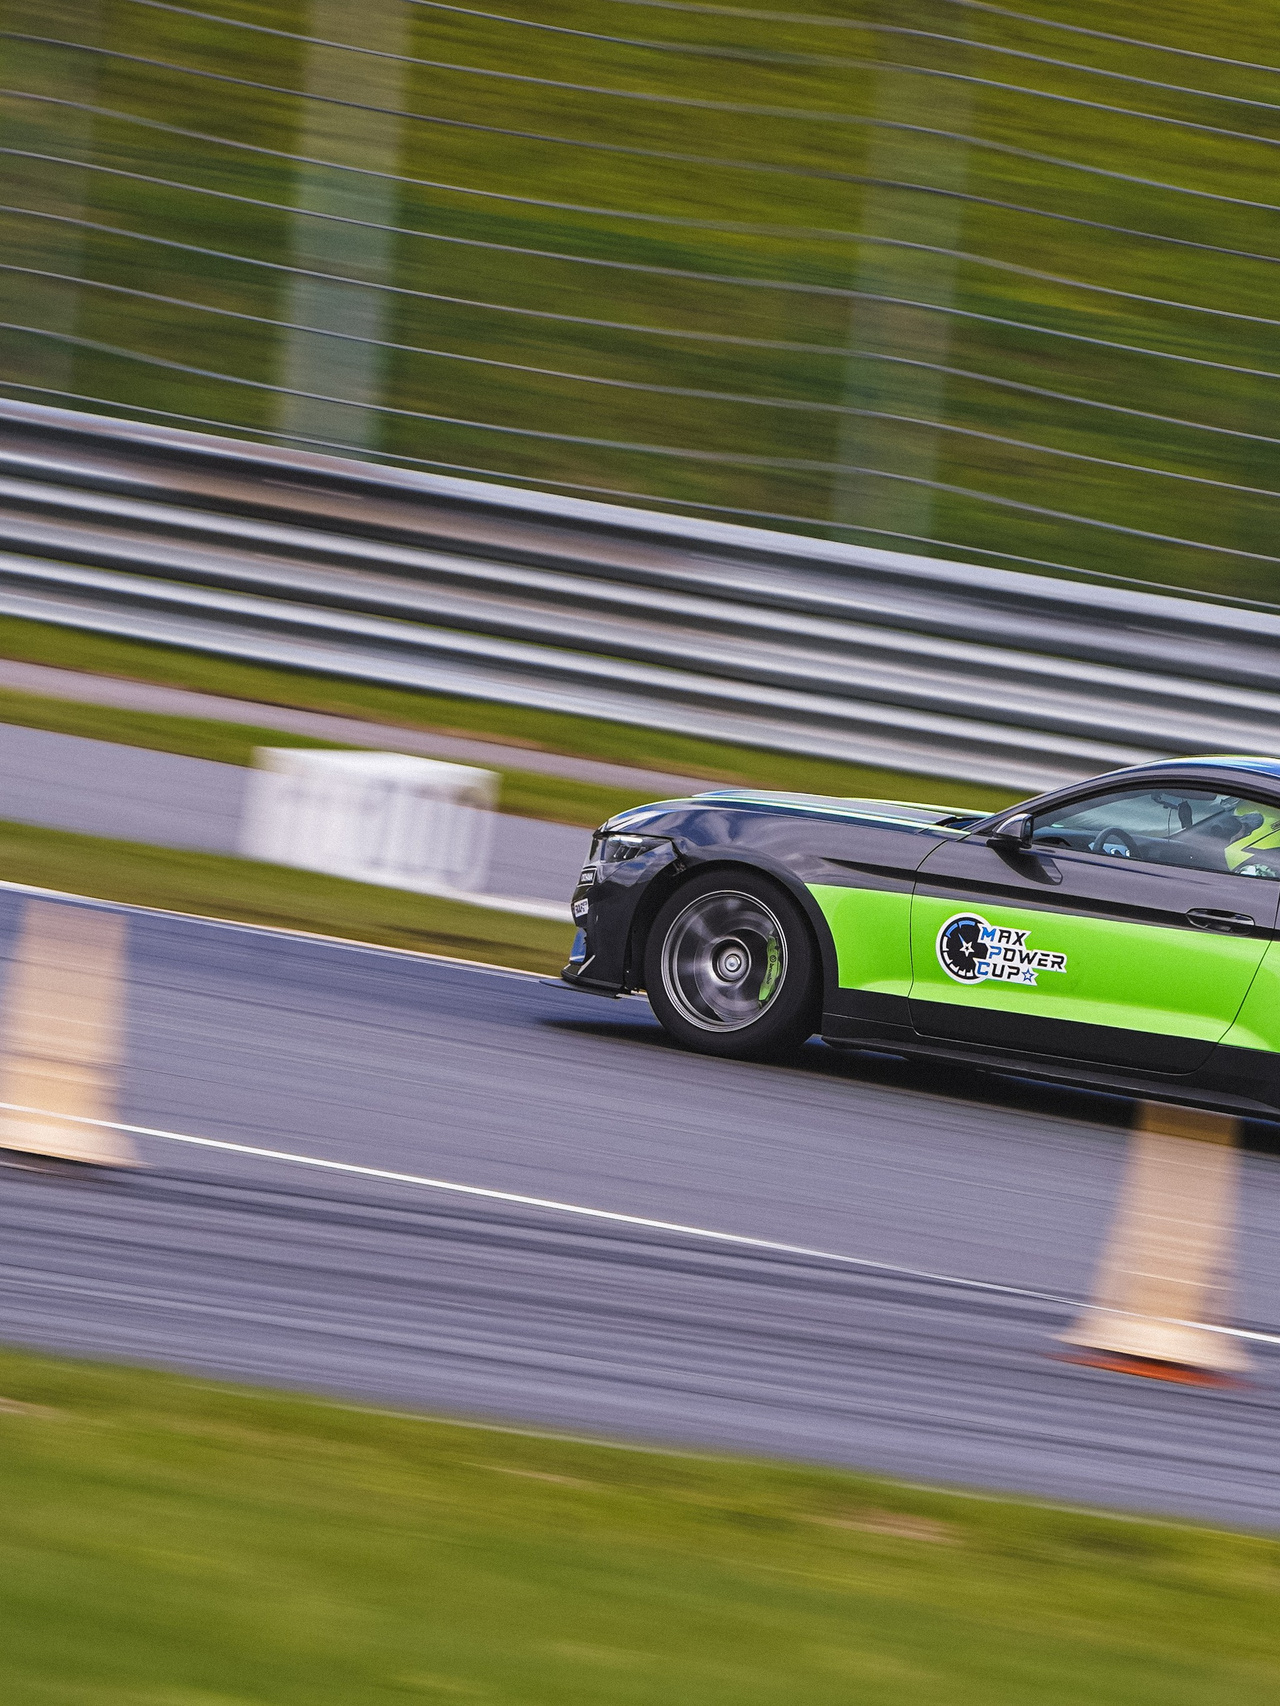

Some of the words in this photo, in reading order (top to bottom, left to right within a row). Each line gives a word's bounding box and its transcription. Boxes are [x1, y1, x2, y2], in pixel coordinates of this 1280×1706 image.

[980, 926, 1026, 946] MAX
[988, 945, 1065, 970] POWER
[977, 961, 1020, 980] CUP
